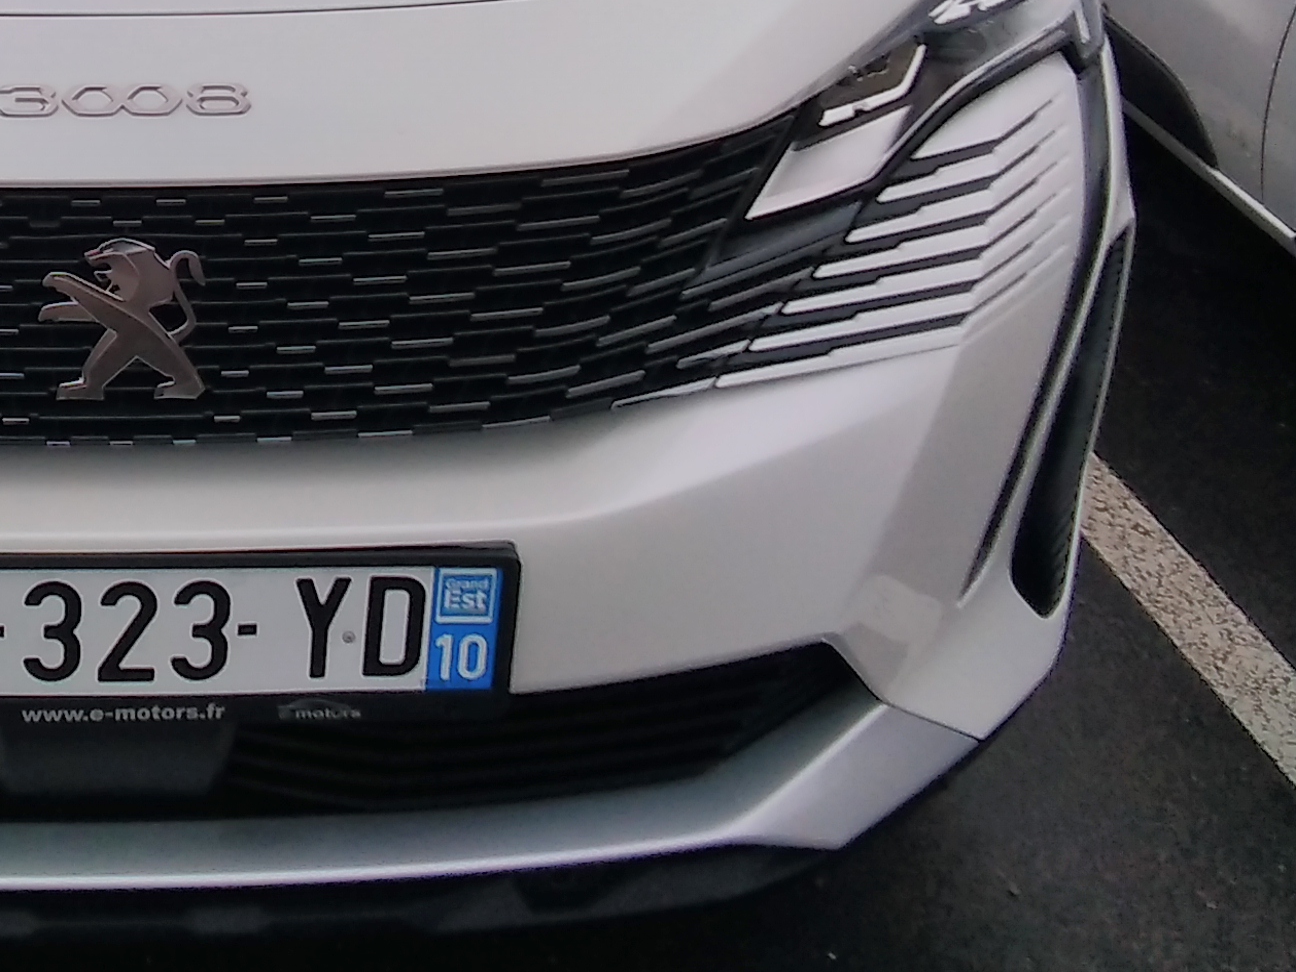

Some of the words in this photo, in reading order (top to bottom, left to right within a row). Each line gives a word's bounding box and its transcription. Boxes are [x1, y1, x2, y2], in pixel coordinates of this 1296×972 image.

[444, 588, 488, 609] Est
[435, 633, 488, 682] 10
[21, 702, 226, 723] www.e-motors.fr
